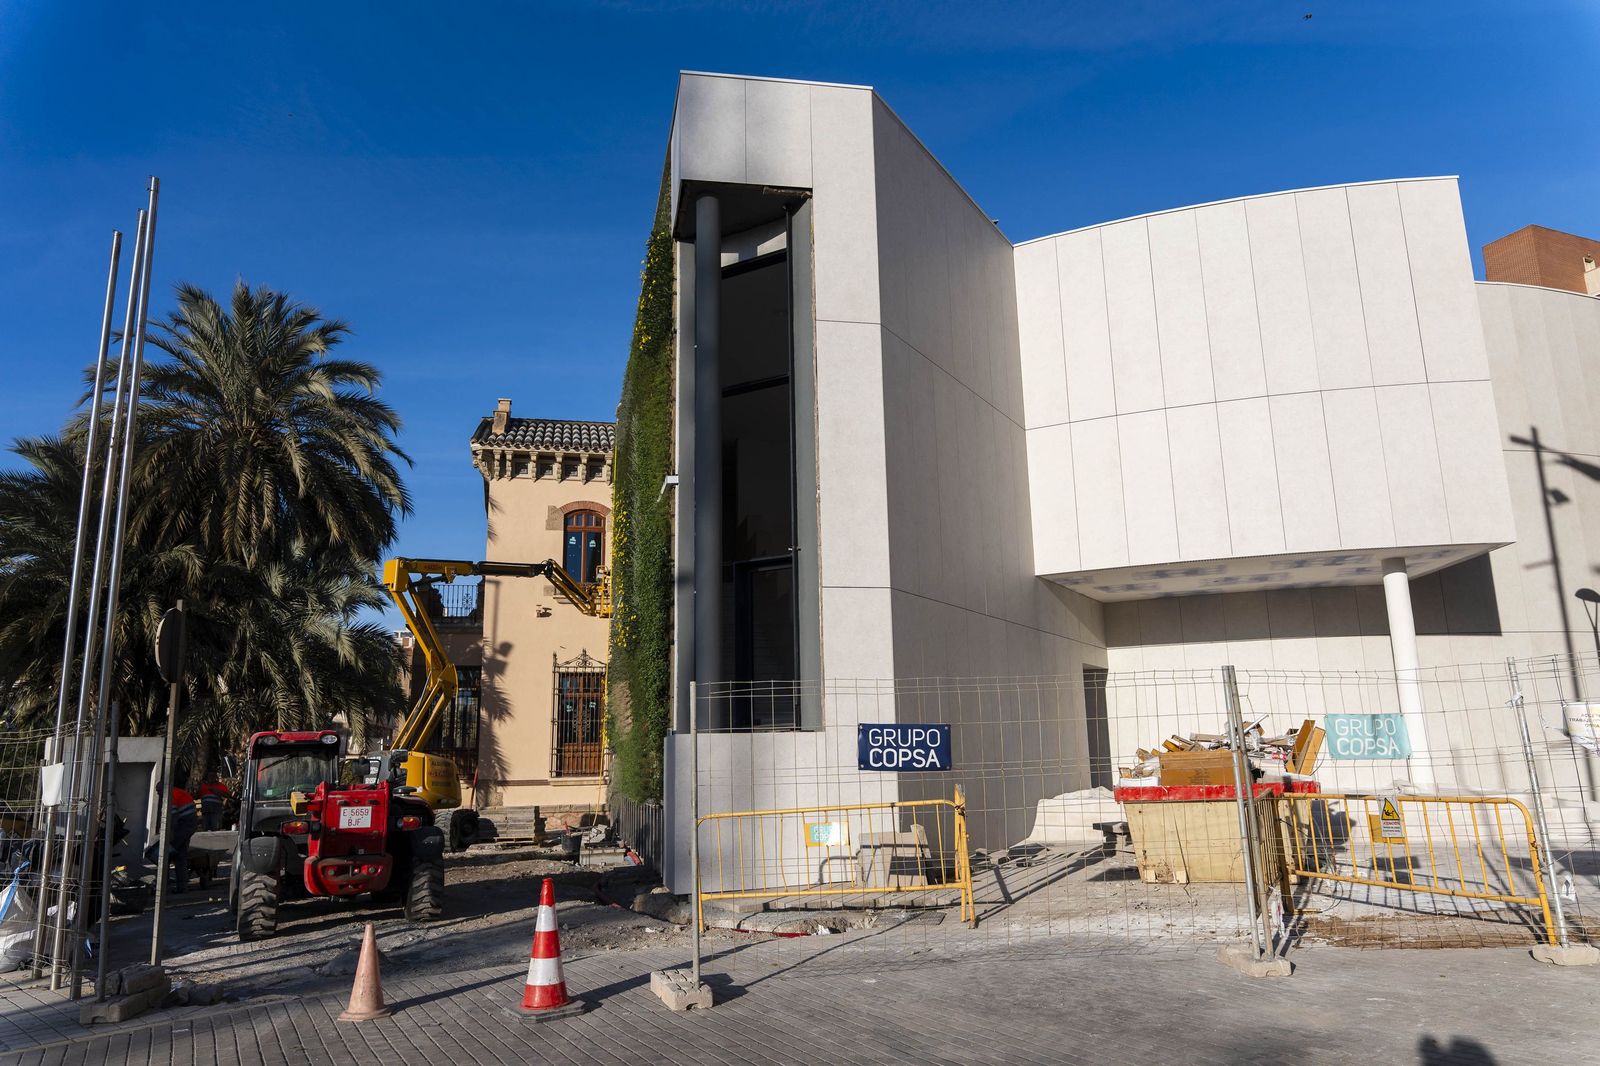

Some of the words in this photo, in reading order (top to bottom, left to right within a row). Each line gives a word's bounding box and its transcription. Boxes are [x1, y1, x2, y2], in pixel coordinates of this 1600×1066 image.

[1336, 718, 1397, 737] GRUPO
[868, 728, 941, 747] GRUPO
[1336, 736, 1401, 756] COPSA
[869, 747, 941, 768] COPSA
[343, 808, 348, 817] E
[351, 808, 369, 817] 5659
